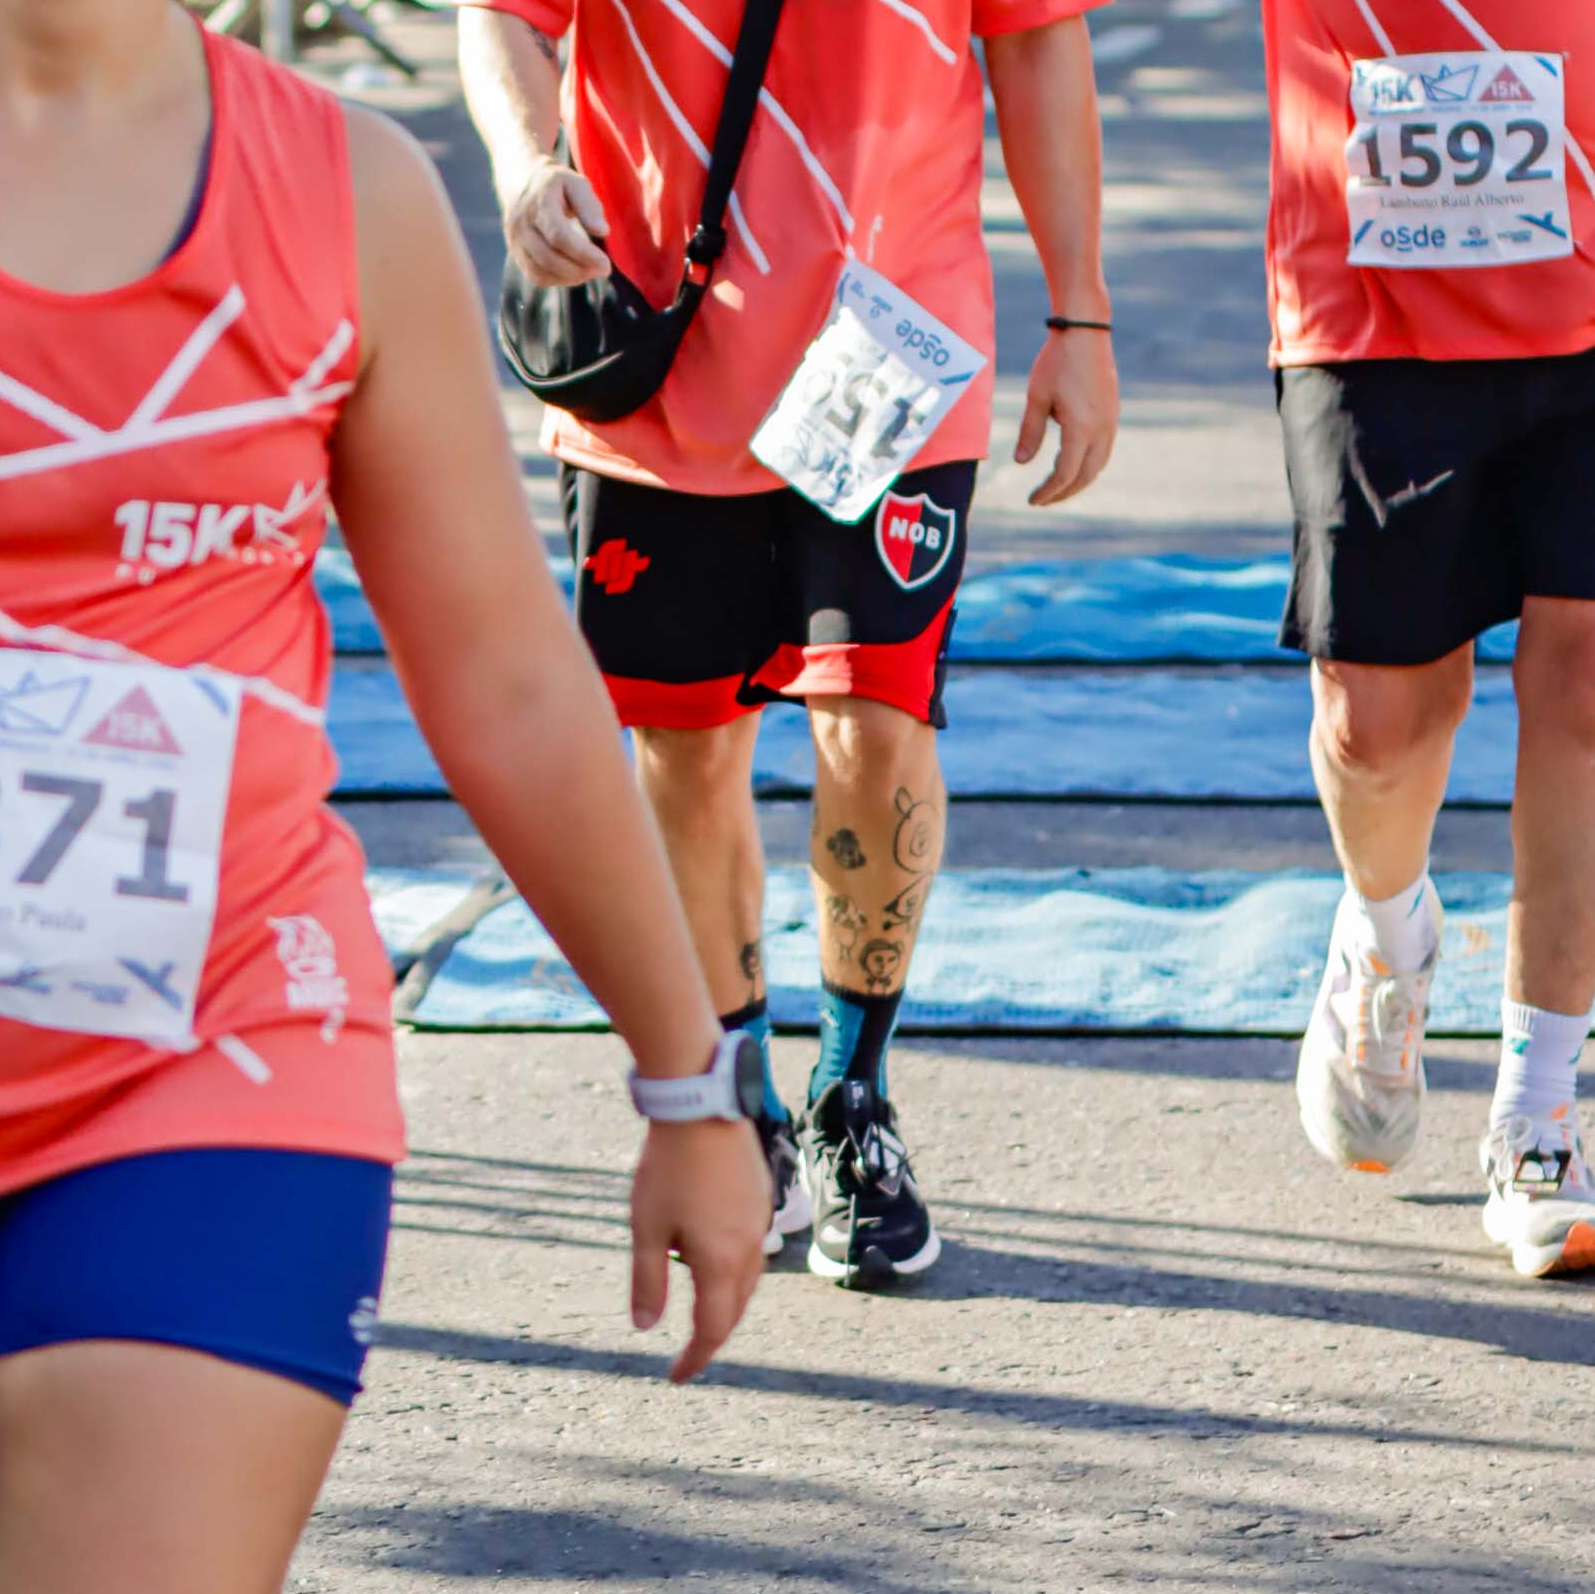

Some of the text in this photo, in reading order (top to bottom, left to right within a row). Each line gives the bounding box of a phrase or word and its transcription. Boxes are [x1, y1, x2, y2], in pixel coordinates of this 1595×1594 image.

[1360, 118, 1553, 189] 1592
[1380, 222, 1447, 253] osde
[896, 319, 952, 368] osde
[114, 499, 251, 568] 15K
[889, 516, 942, 550] NOB
